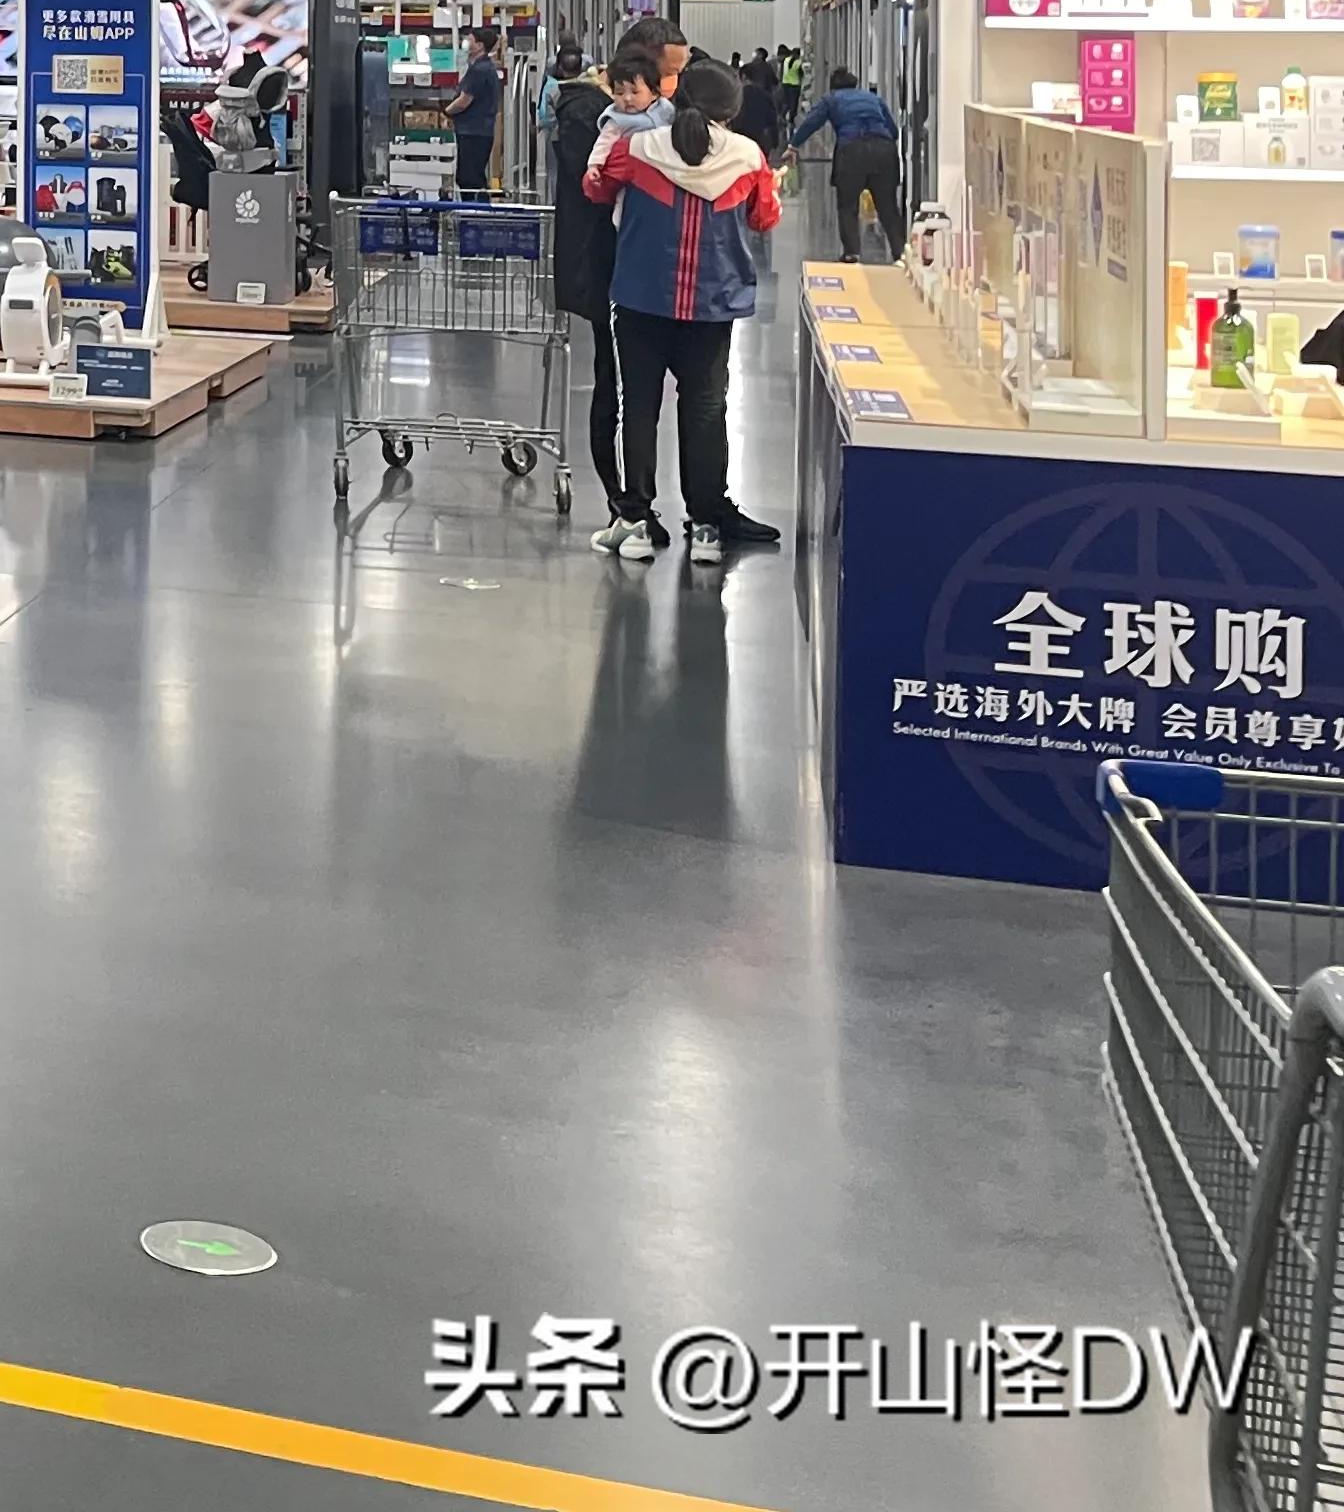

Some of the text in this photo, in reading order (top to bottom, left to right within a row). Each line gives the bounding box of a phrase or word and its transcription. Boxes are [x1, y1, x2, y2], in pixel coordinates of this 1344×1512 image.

[993, 590, 1307, 700] 全球购
[892, 678, 1135, 734] 严选海外大牌
[892, 720, 1340, 776] Selected International Brands With Great Value Only Exclusive To
